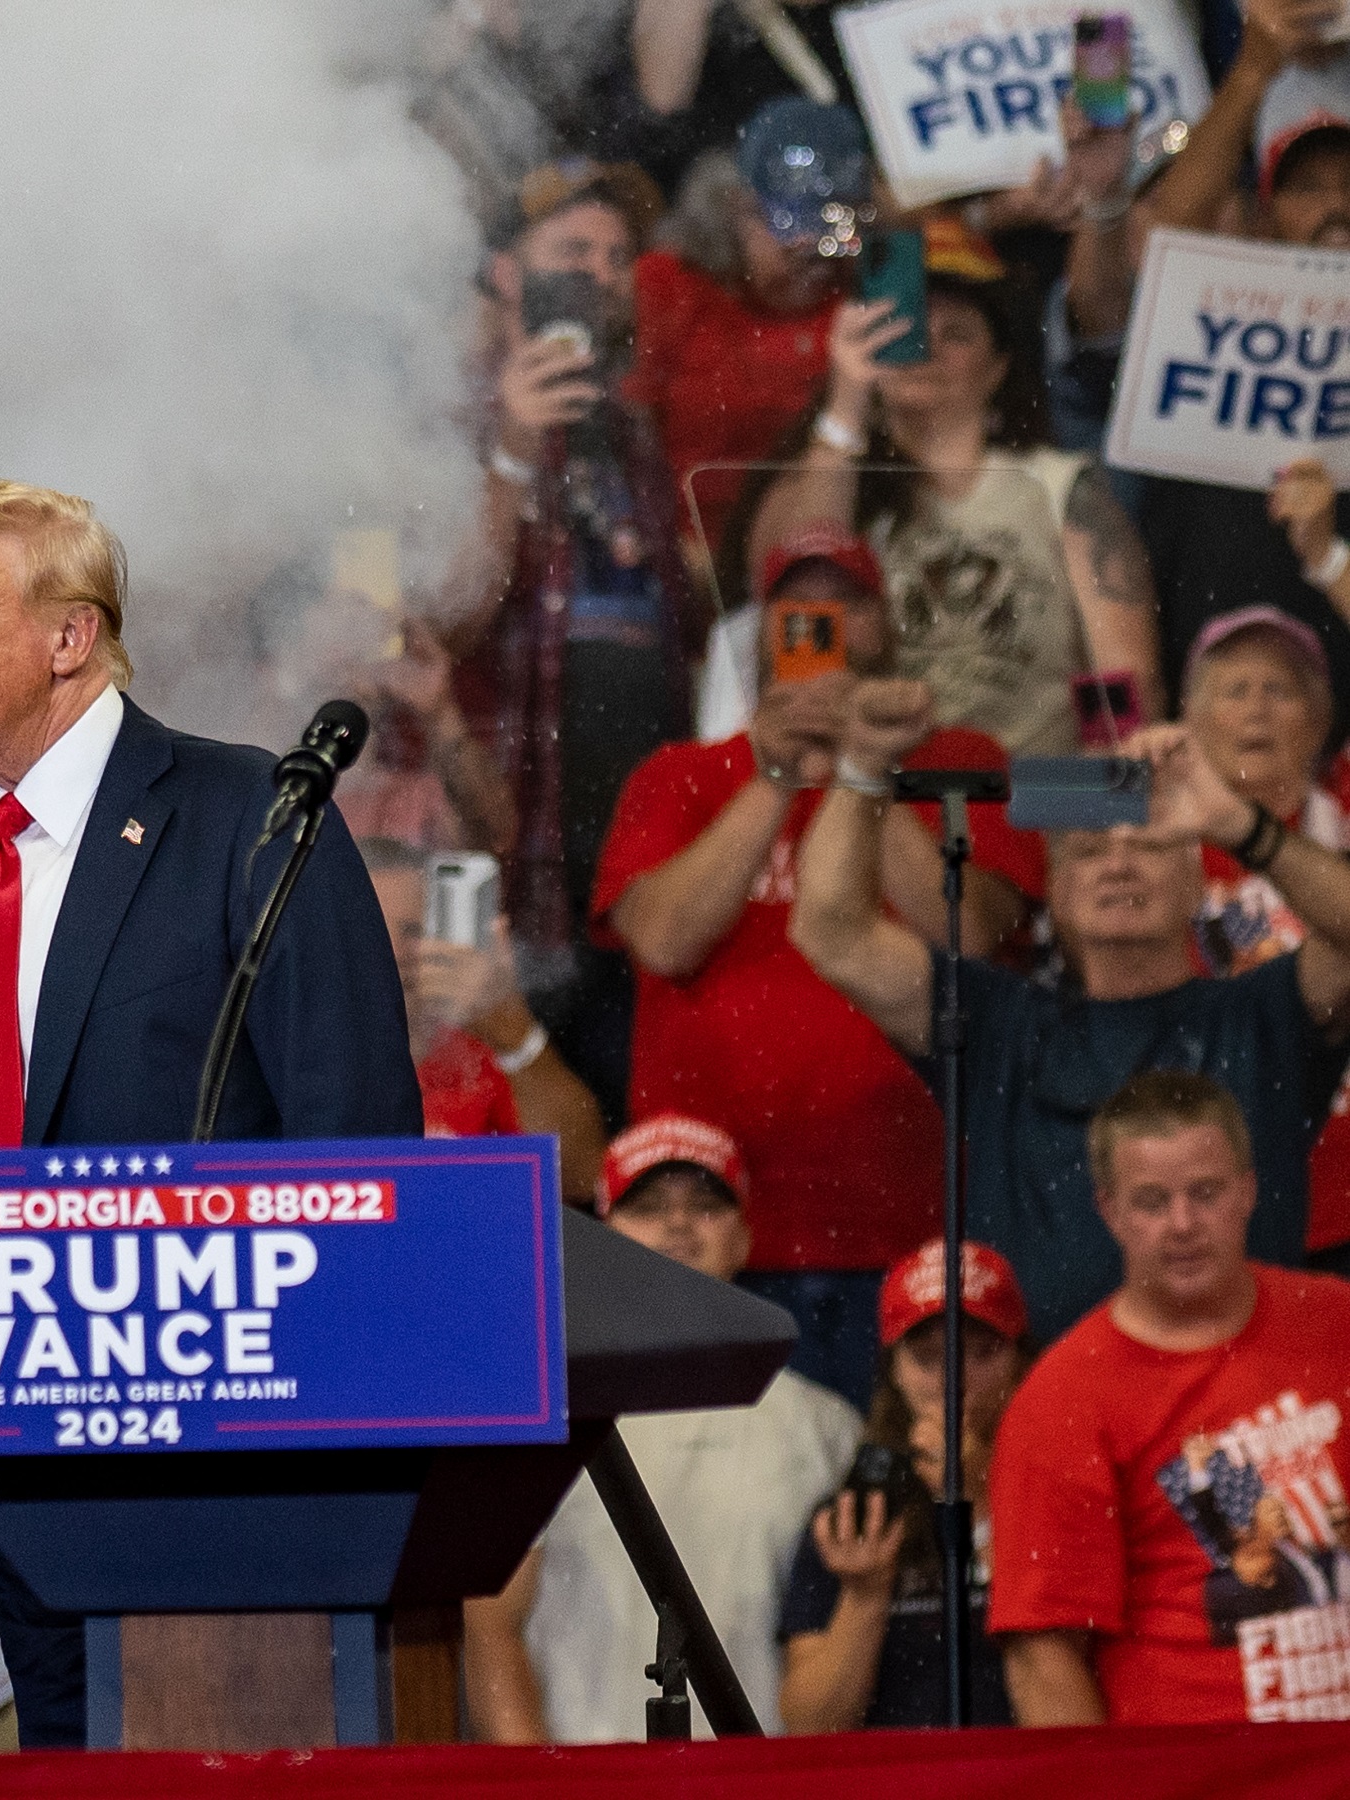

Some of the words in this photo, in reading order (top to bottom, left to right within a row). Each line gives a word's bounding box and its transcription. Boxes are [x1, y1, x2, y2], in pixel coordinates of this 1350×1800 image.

[1156, 361, 1350, 438] FIRE
[176, 1185, 236, 1225] TO
[246, 1180, 383, 1223] 88022
[12, 1381, 122, 1405] AMERICA
[125, 1379, 206, 1403] GREAT
[213, 1376, 298, 1400] AGAIN!
[55, 1406, 183, 1447] 2024
